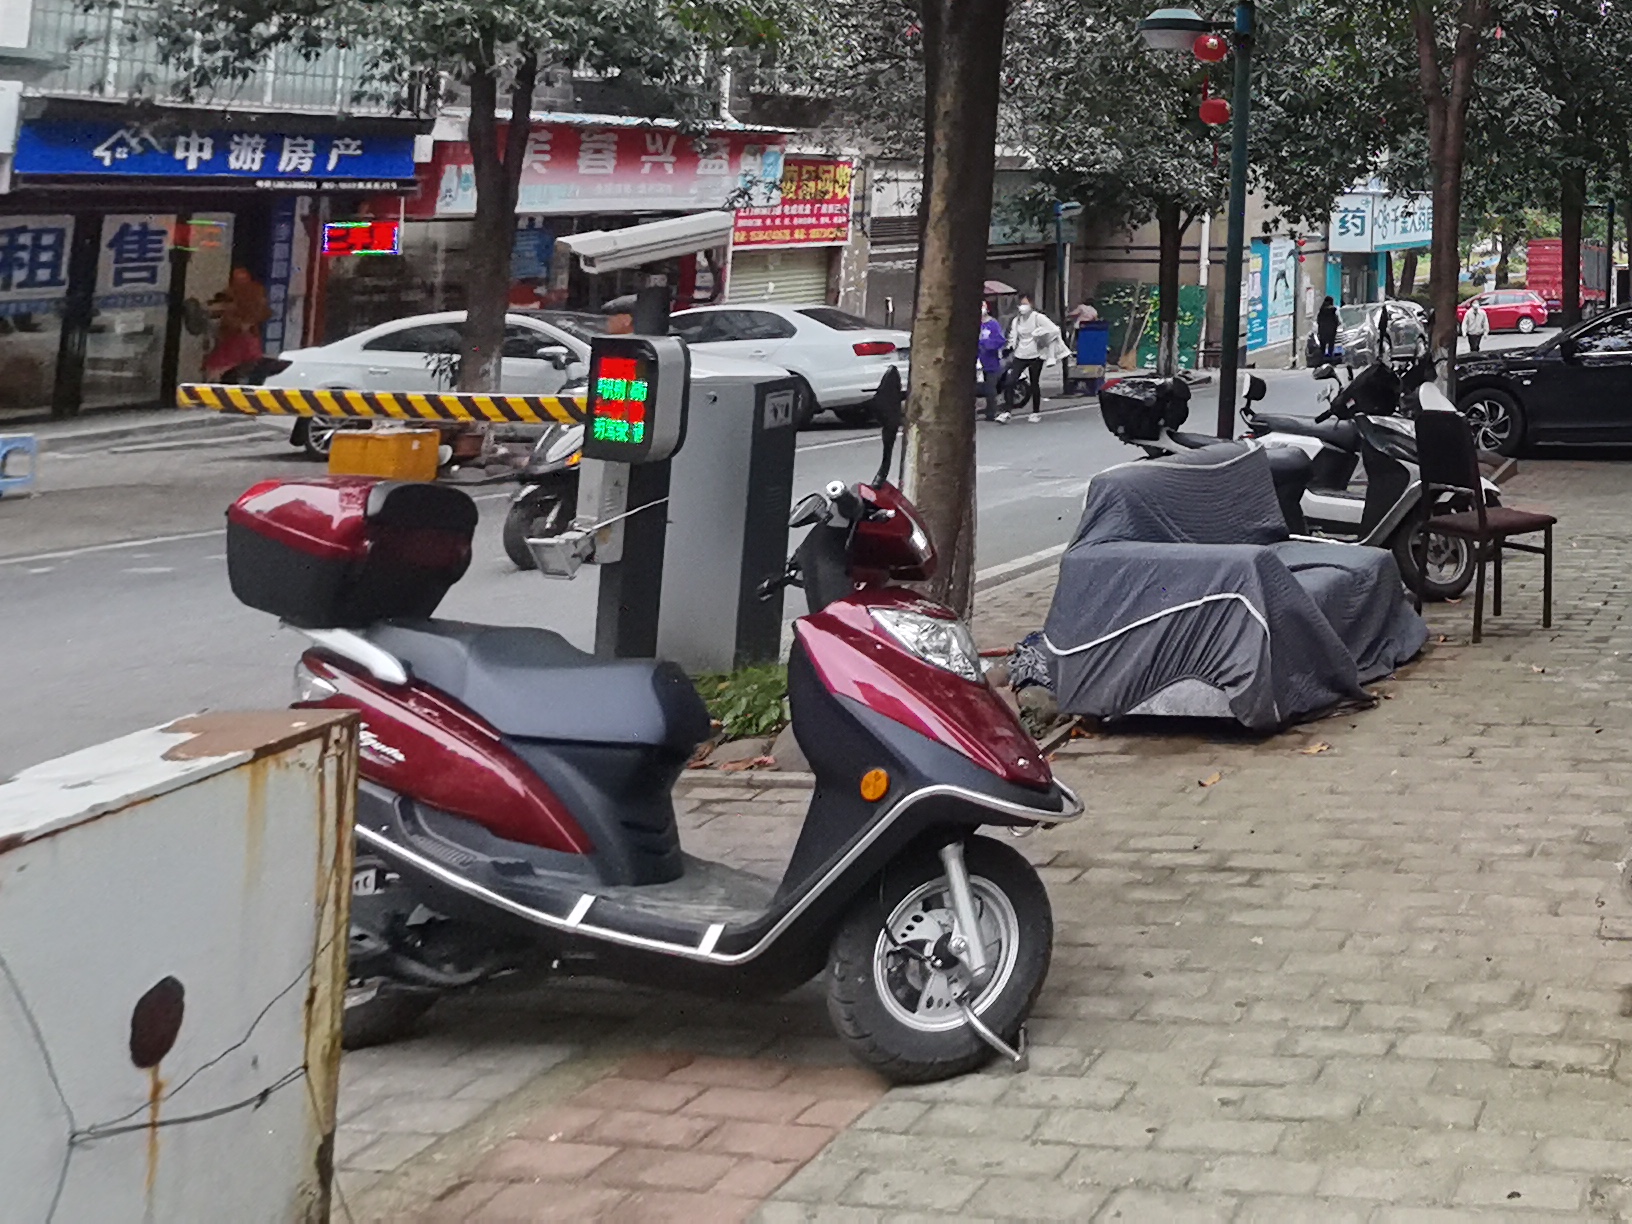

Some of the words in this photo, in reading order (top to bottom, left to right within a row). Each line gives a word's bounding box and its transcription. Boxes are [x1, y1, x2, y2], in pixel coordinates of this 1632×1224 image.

[173, 130, 364, 173] 中游房产
[1338, 207, 1366, 237] 药
[106, 222, 168, 287] 售
